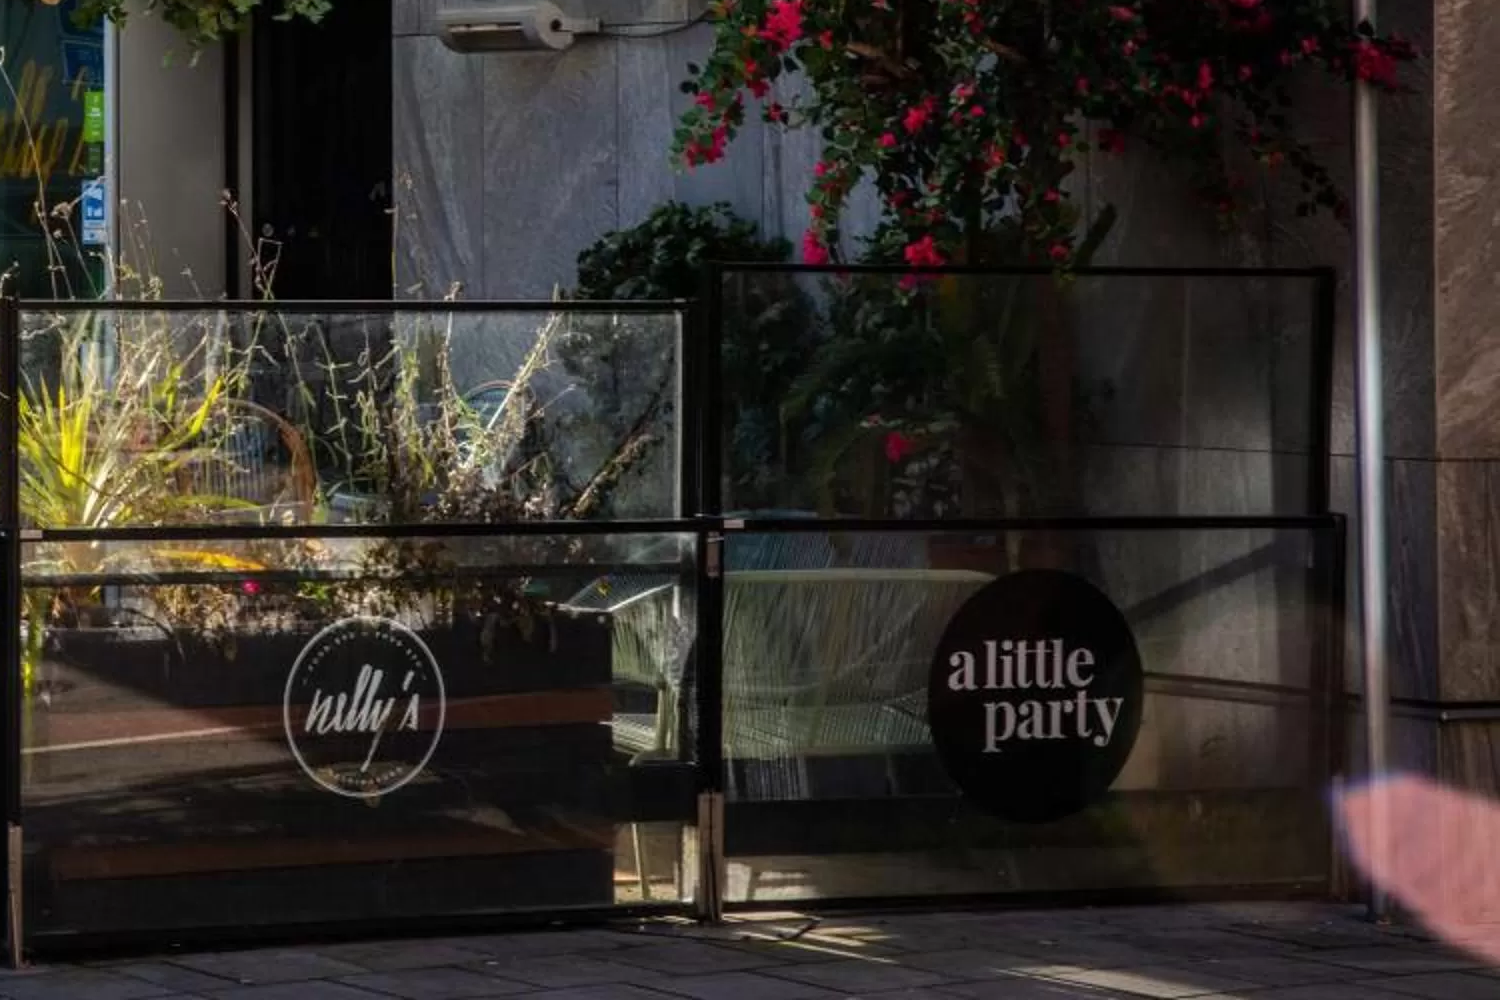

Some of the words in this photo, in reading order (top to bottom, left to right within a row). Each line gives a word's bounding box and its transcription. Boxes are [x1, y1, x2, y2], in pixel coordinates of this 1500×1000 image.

[948, 650, 978, 691] a
[982, 637, 1096, 689] little
[304, 663, 420, 773] nelly's
[982, 689, 1125, 753] party
